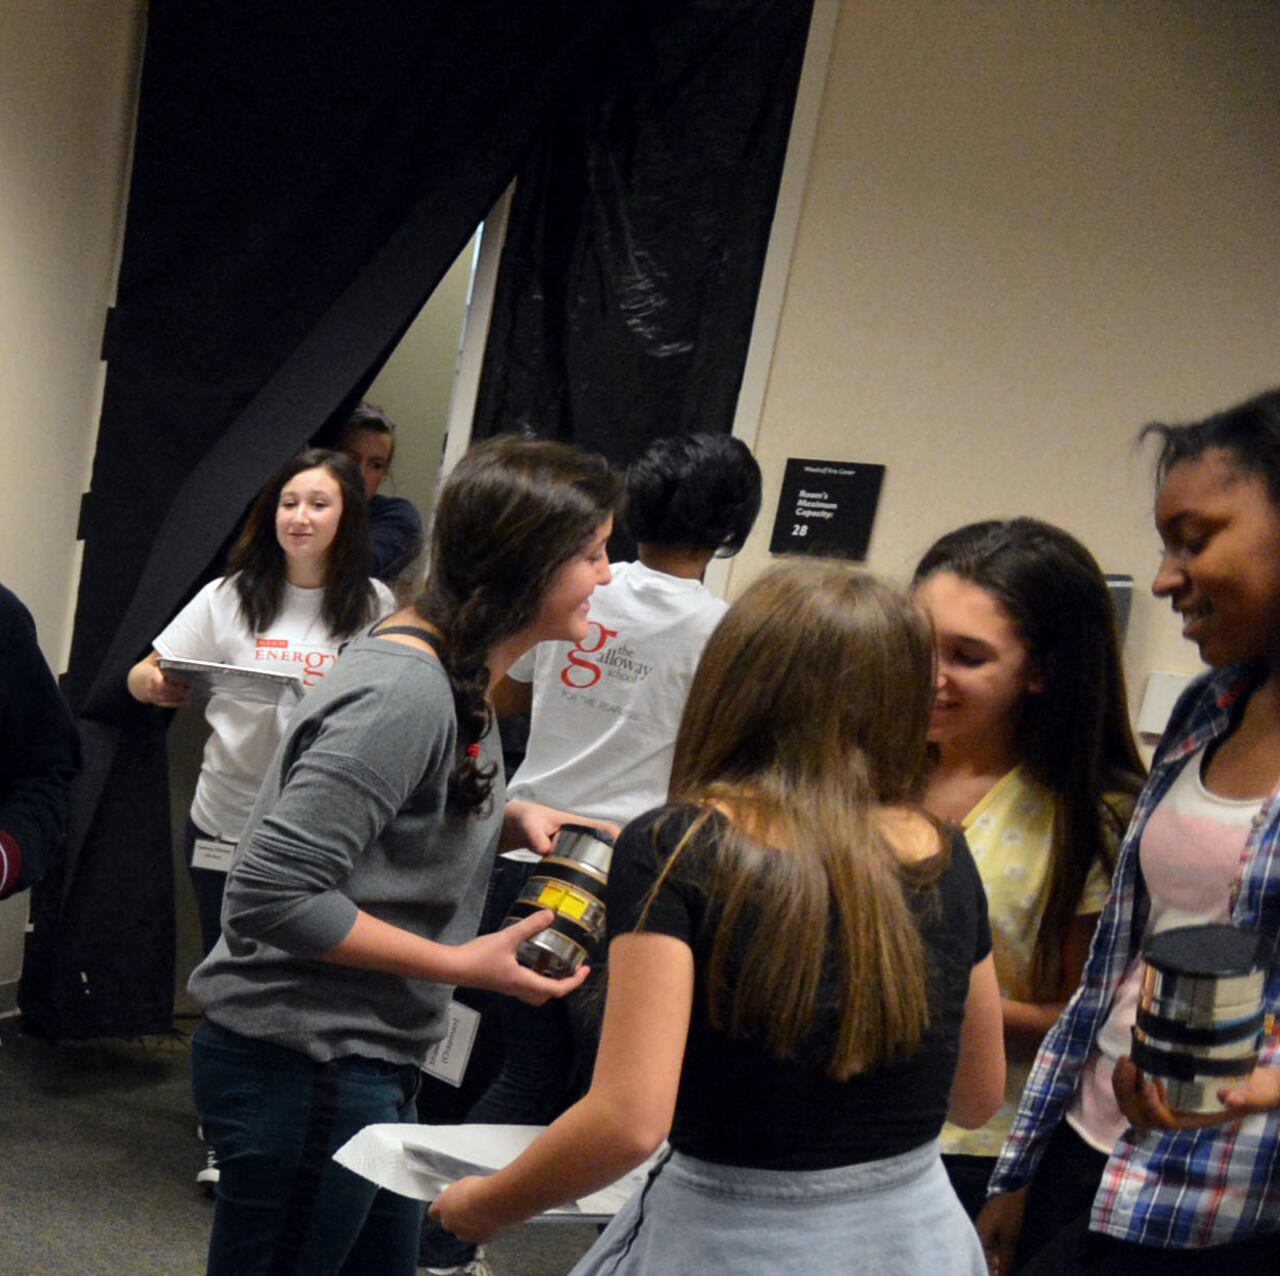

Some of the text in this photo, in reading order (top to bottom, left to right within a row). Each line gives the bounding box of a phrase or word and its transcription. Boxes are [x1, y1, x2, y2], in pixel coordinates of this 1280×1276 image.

[799, 489, 828, 500] Room's
[796, 499, 838, 510] Maximum
[791, 524, 808, 537] 28
[618, 644, 635, 657] the
